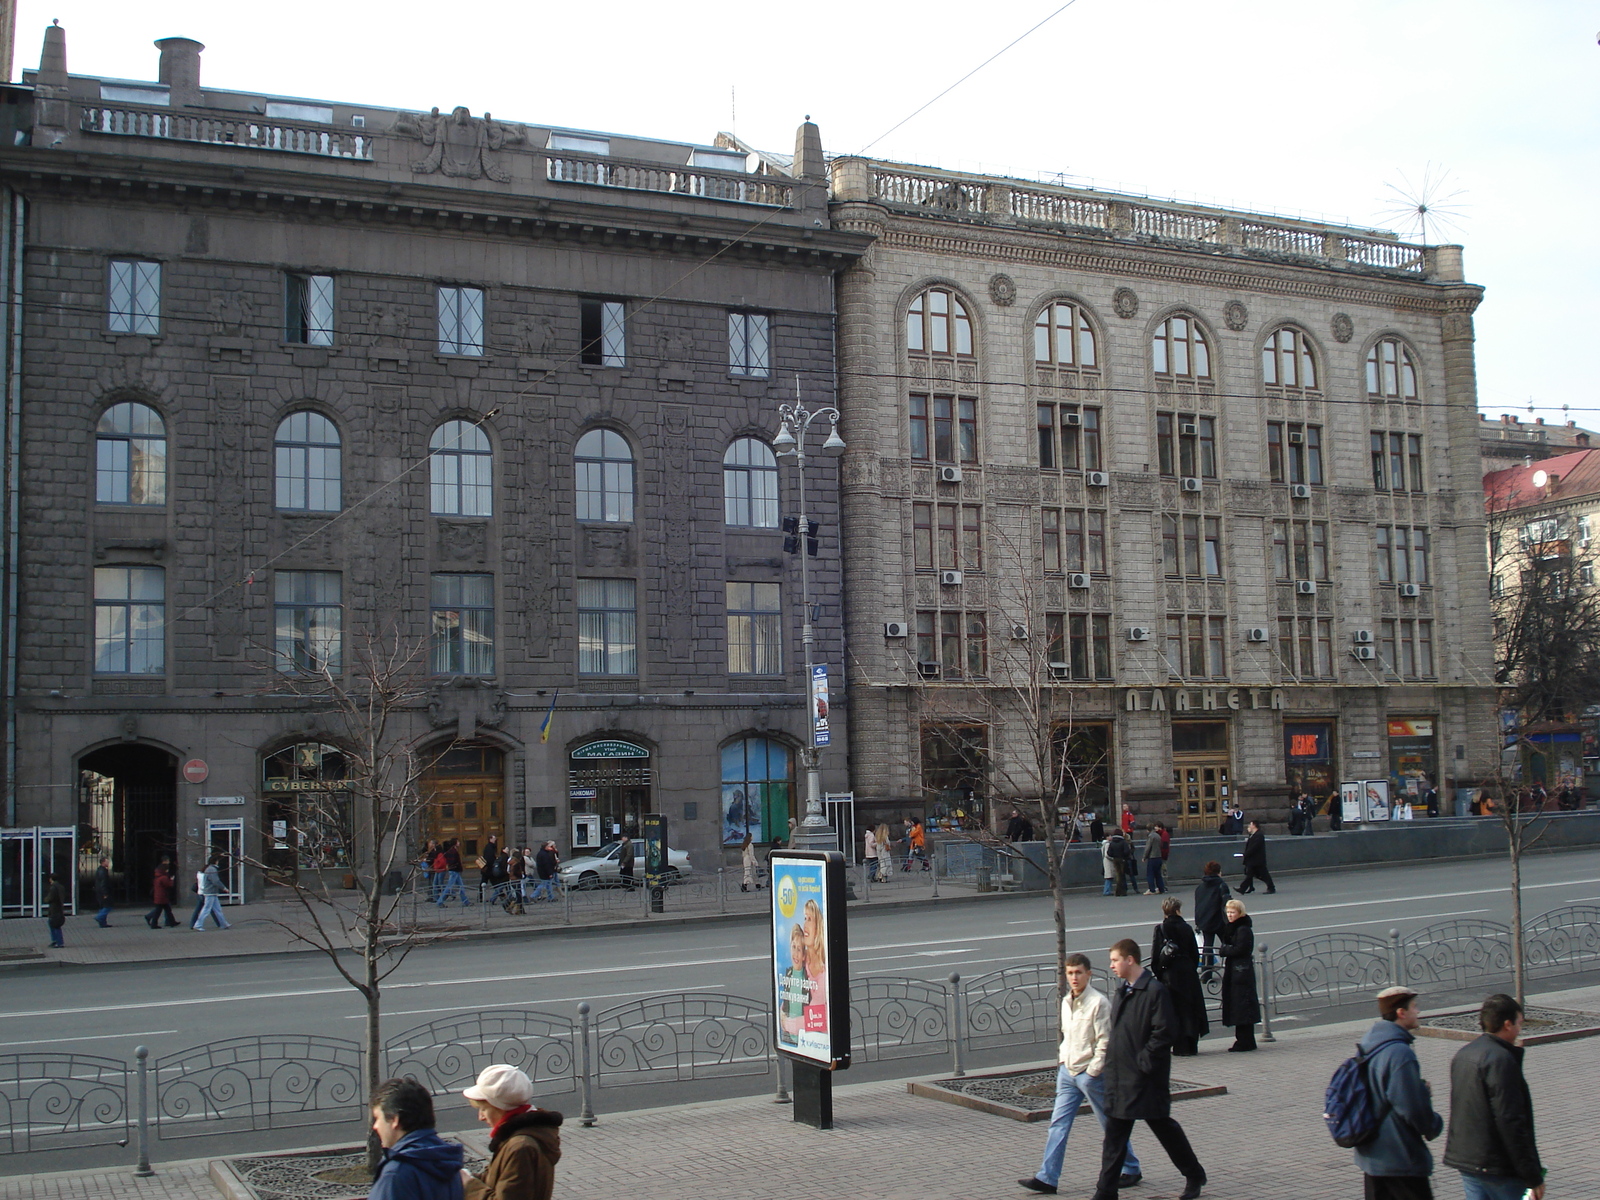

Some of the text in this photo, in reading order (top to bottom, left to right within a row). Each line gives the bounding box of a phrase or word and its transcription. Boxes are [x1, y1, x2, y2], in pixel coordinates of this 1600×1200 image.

[1126, 688, 1285, 711] ПЛАНЕТА
[1290, 734, 1318, 756] JEANS
[234, 796, 243, 804] 32
[779, 974, 800, 988] Даруйте
